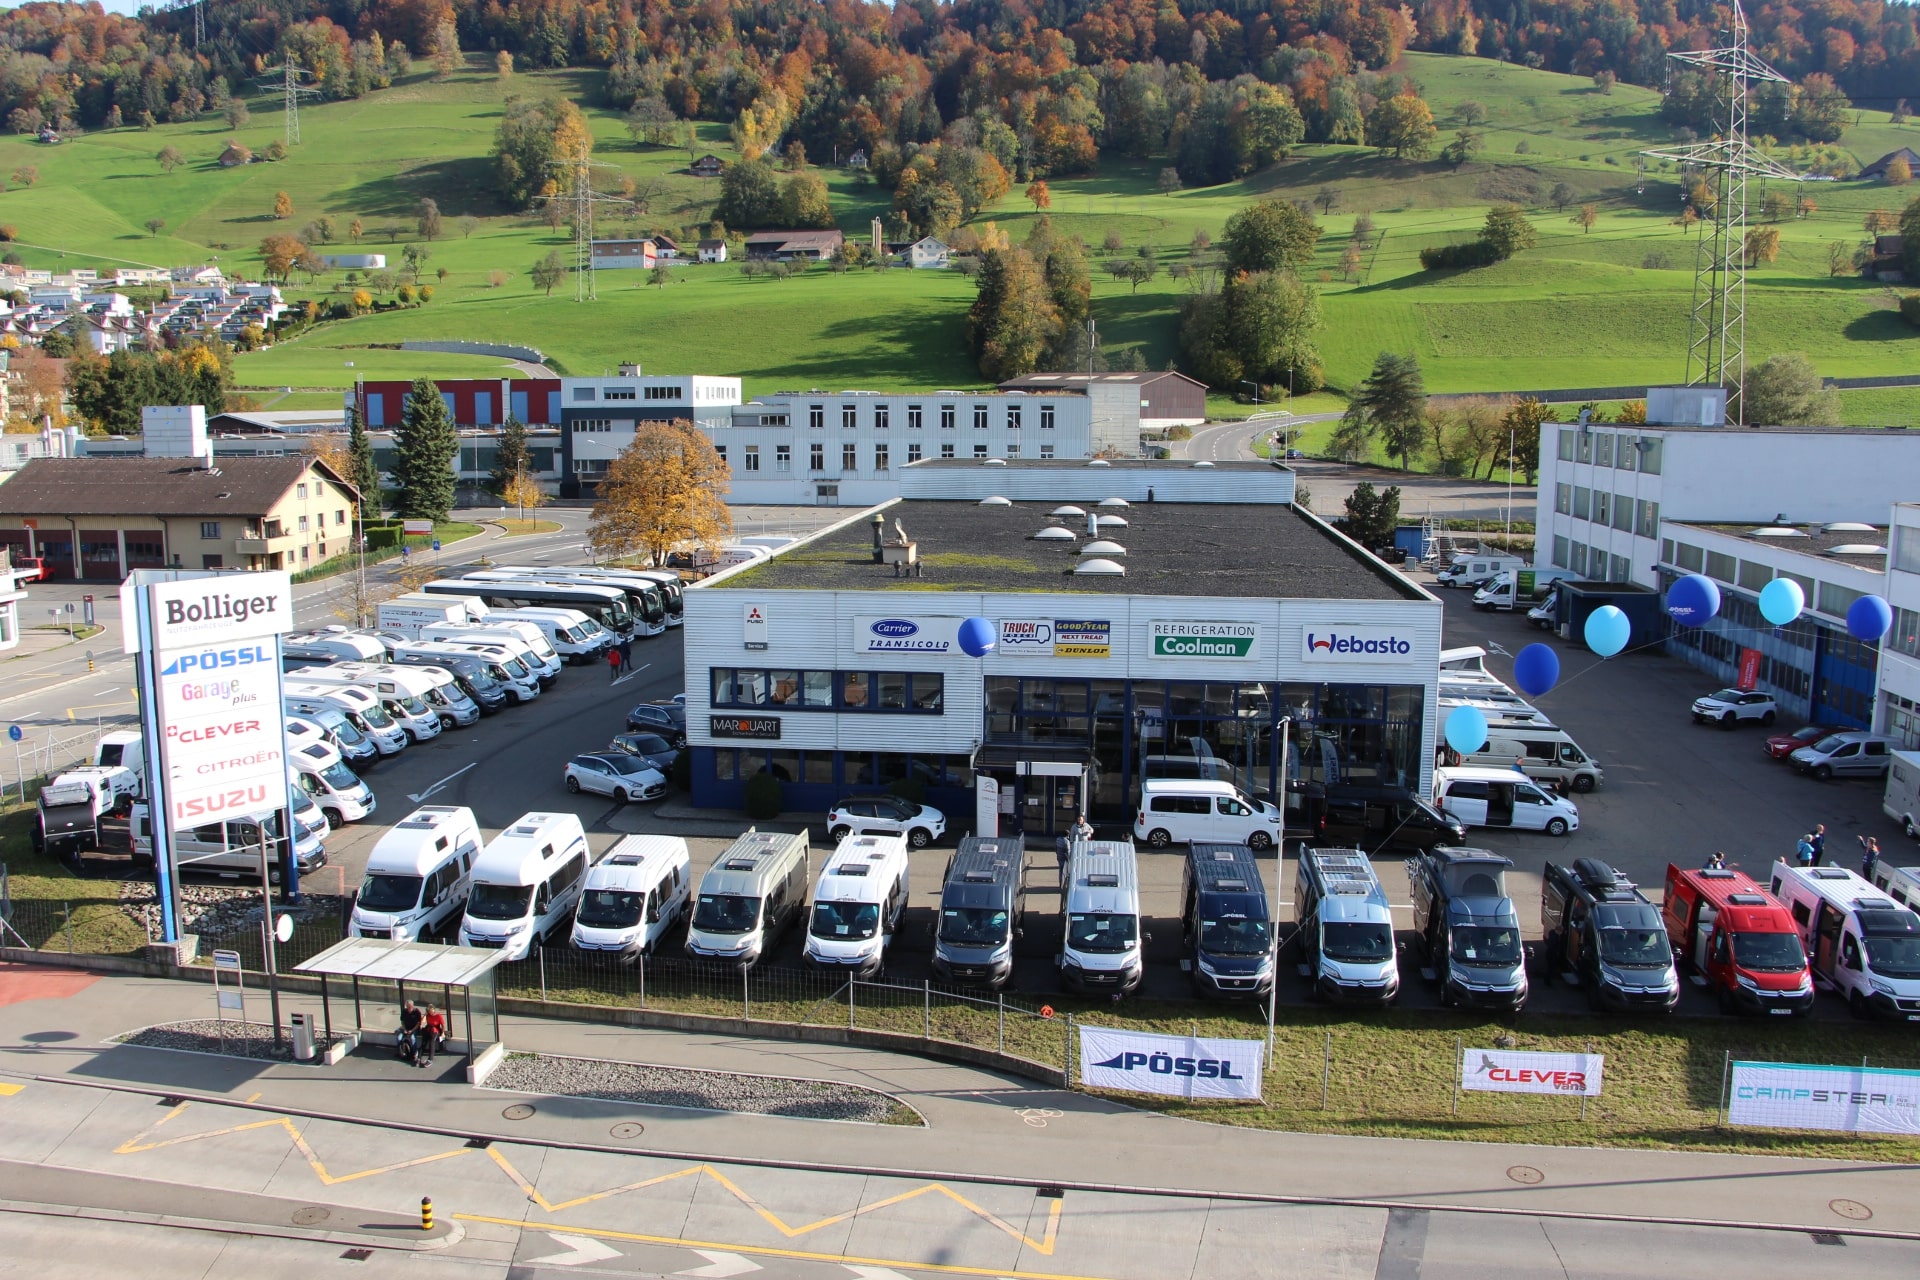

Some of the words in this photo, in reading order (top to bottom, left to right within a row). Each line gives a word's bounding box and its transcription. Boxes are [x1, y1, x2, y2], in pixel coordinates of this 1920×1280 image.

[165, 594, 278, 624] Bolliger
[877, 623, 913, 633] Carrier
[1003, 622, 1036, 633] TRUCK
[1056, 622, 1109, 631] GOODYEAR
[1154, 624, 1255, 636] REFRIGERATION
[869, 639, 950, 649] TRANSICOLD
[1162, 637, 1236, 655] Coolman
[1307, 633, 1411, 655] Webasto
[180, 646, 273, 674] PÖSSL
[181, 679, 240, 701] Garage
[232, 693, 257, 706] plus
[179, 720, 261, 743] CLEVER
[713, 719, 777, 732] MARQUART
[196, 750, 280, 775] CITROËN
[176, 785, 266, 819] ISUZU
[1124, 1051, 1243, 1080] PÖSSL
[1488, 1068, 1586, 1086] CLEVER
